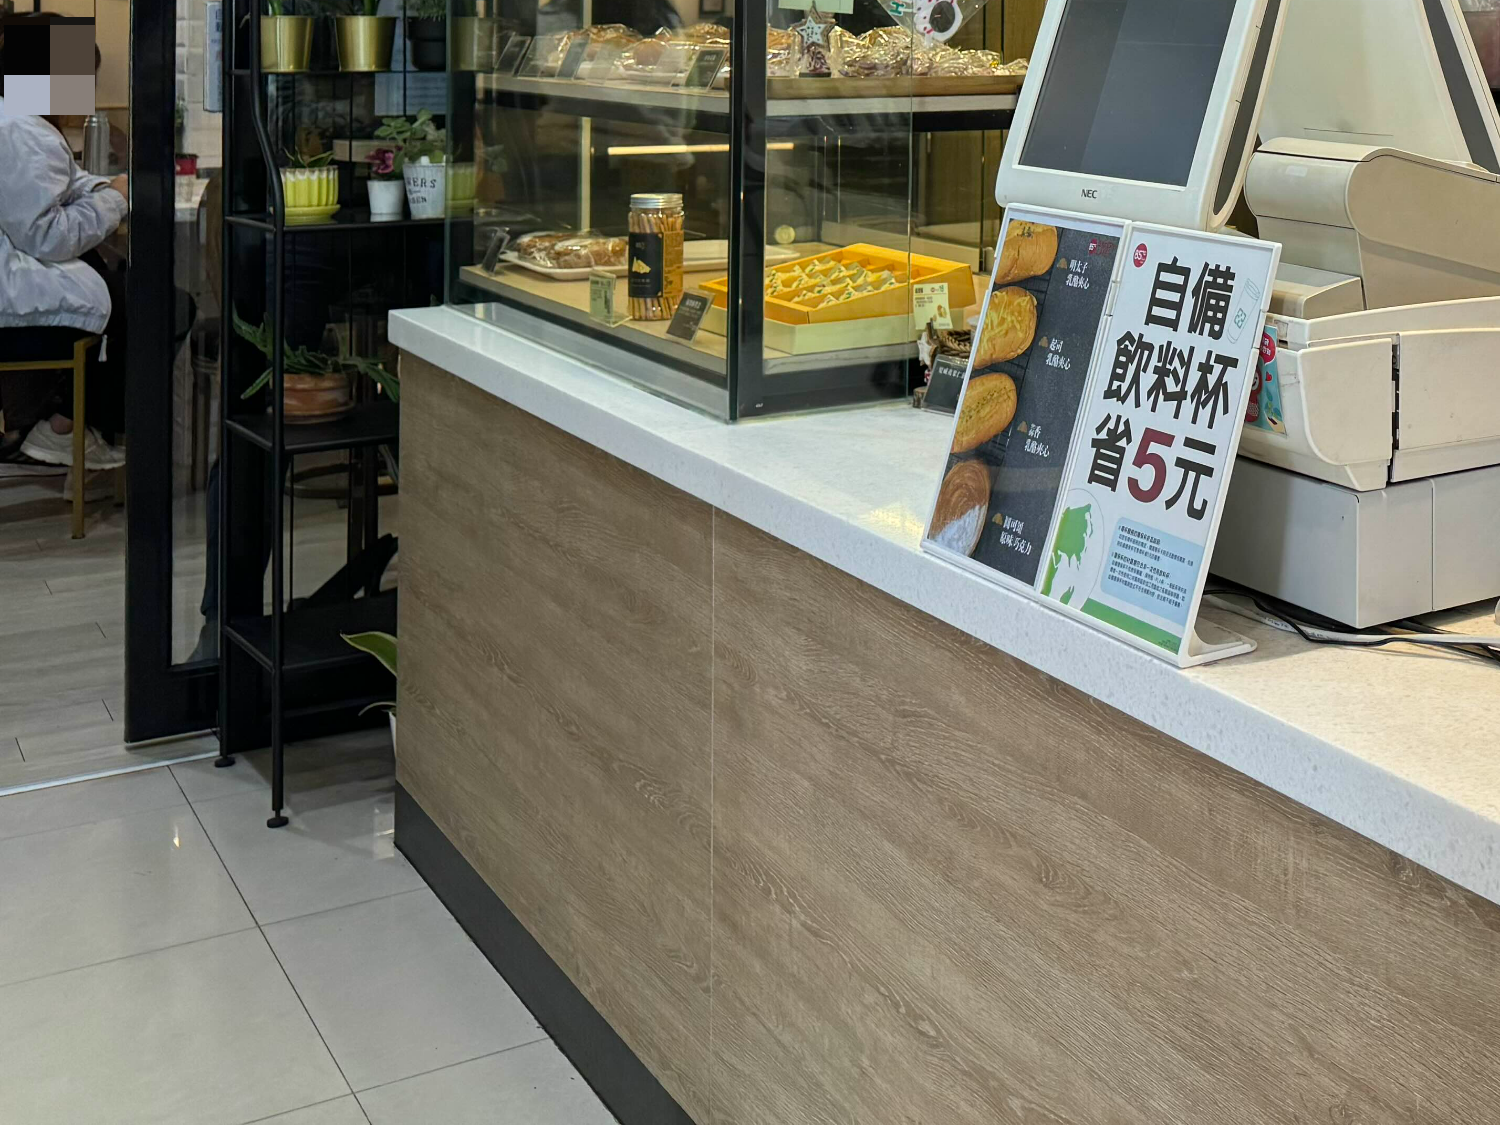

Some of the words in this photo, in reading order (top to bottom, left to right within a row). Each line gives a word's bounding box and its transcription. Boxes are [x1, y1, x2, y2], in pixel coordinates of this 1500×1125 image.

[1081, 189, 1097, 199] NEC
[1144, 256, 1237, 342] 自備
[1103, 330, 1239, 430] 飲料杯
[1087, 413, 1217, 522] 省5元
